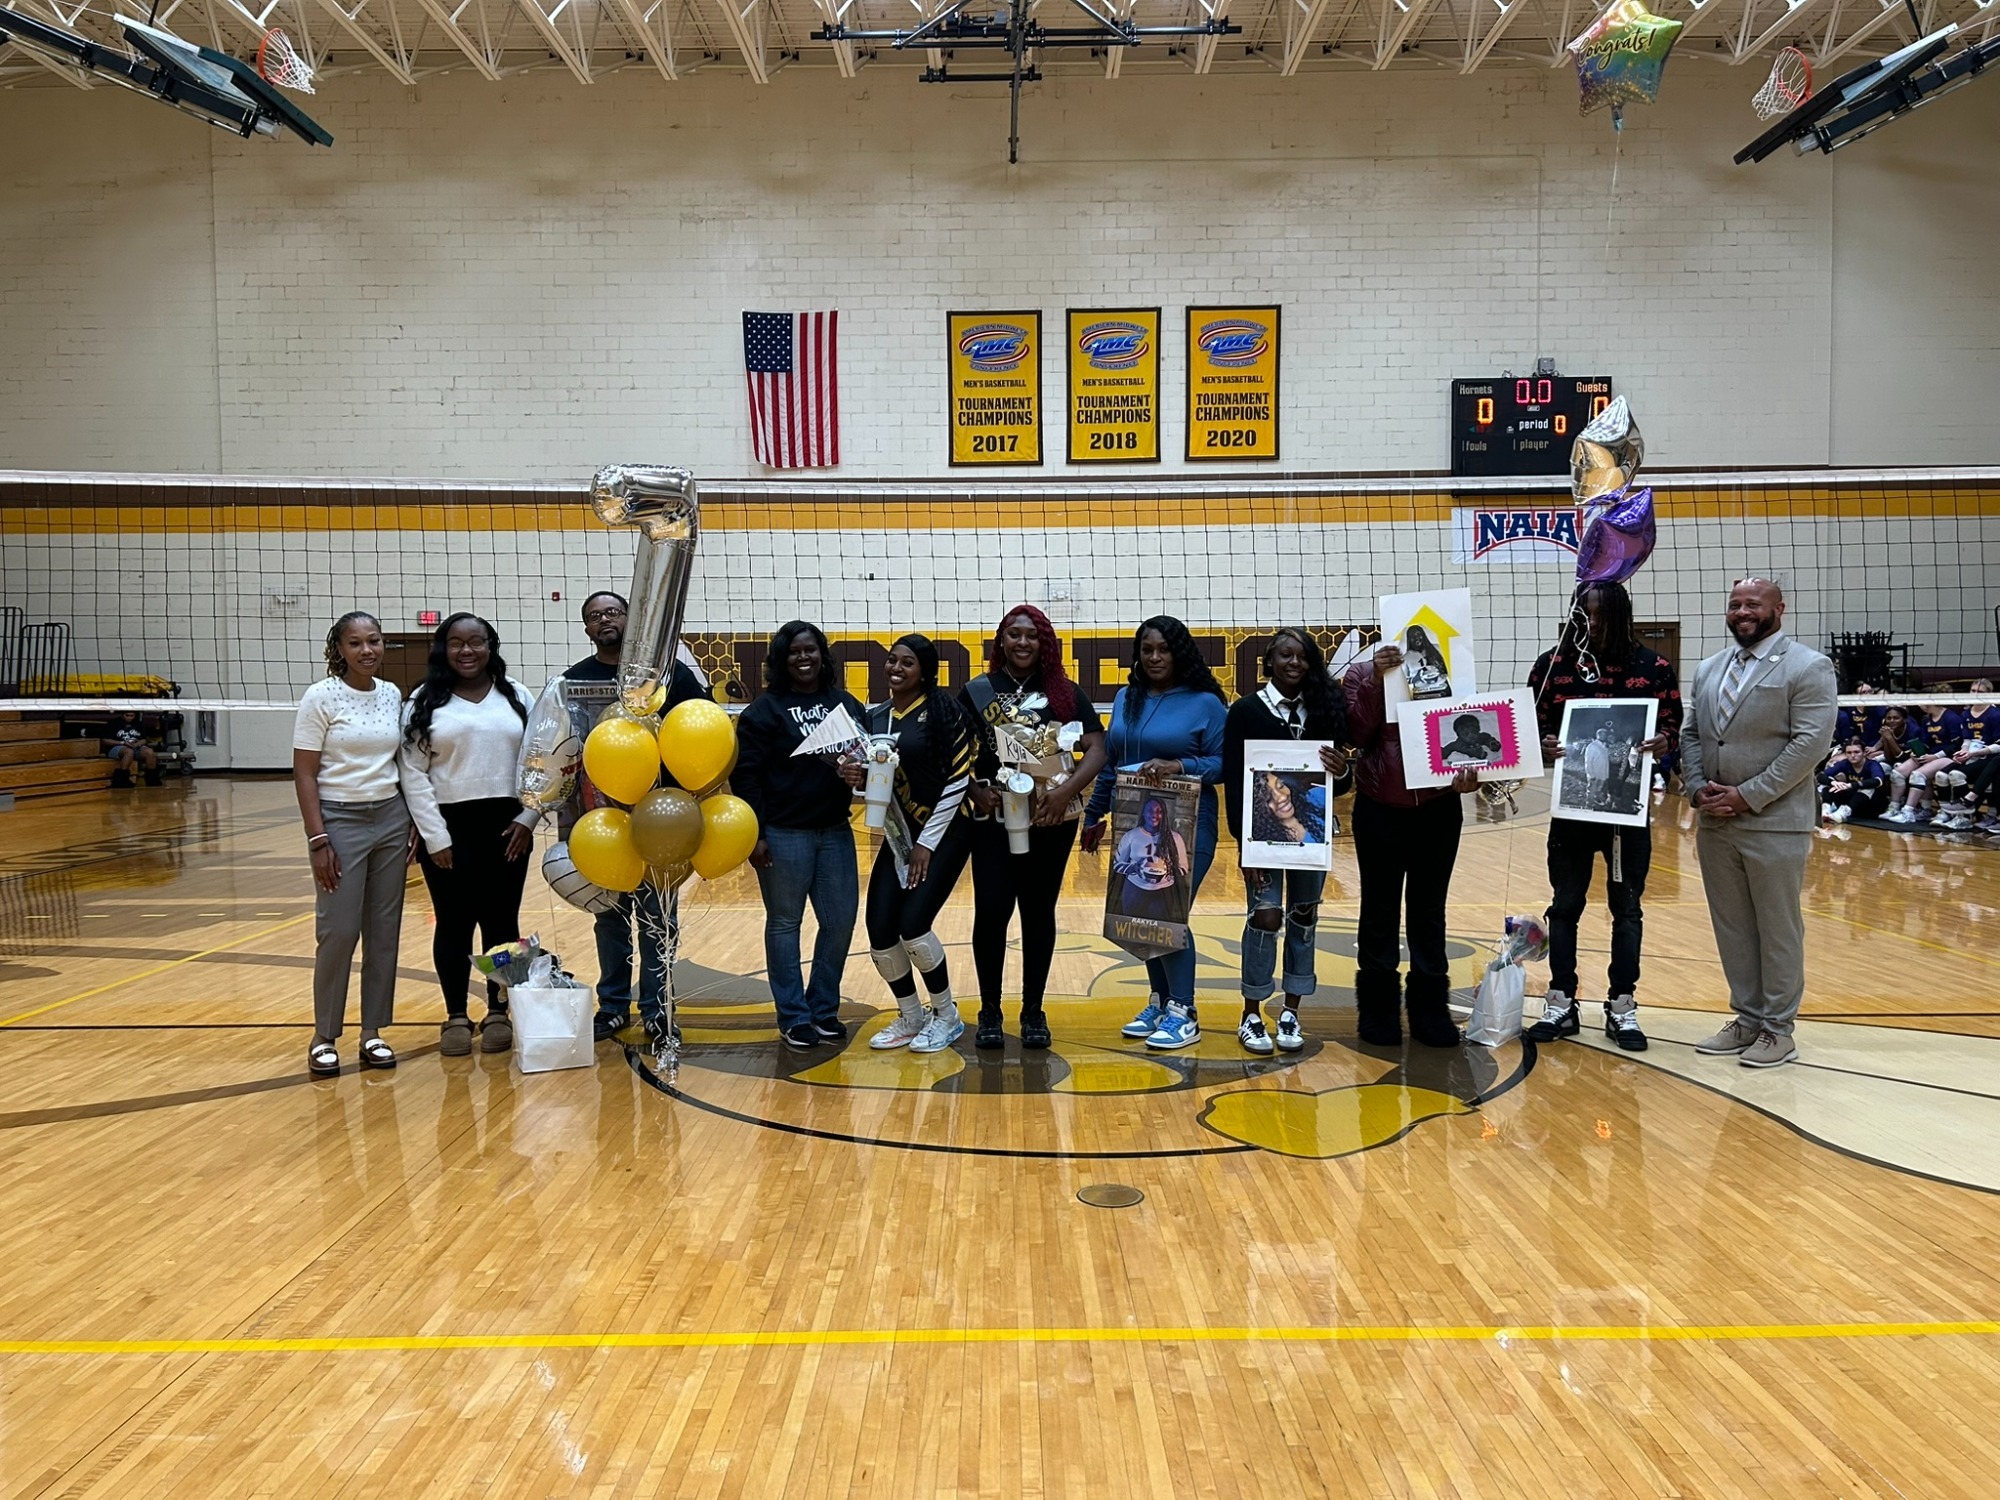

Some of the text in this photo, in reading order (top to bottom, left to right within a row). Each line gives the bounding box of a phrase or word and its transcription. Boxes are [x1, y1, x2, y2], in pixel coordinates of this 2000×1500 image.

[1577, 27, 1657, 70] Congrats!
[963, 337, 1022, 359] AMC
[1083, 335, 1142, 357] AMC
[1201, 334, 1260, 355] AMC
[964, 379, 1026, 388] MEN'S BASKETBALL
[1082, 377, 1145, 386] MEN'S BASKETBALL
[1201, 375, 1264, 384] MEN'S BASKETBALL
[1576, 381, 1608, 393] Guests
[1459, 383, 1493, 395] Hornets
[1516, 380, 1551, 404] 0.0
[958, 397, 1032, 410] TOURNAMENT
[1077, 394, 1150, 408] TOURNAMENT
[1196, 393, 1269, 406] TOURNAMENT
[958, 411, 1032, 426] CHAMPIONS
[1076, 409, 1151, 424] CHAMPIONS
[1196, 406, 1269, 421] CHAMPIONS
[1477, 398, 1494, 425] 0
[1519, 418, 1549, 431] period
[1554, 415, 1566, 433] 0
[973, 435, 1018, 453] 2017
[1090, 432, 1137, 449] 2018
[1207, 430, 1257, 447] 2020
[1466, 440, 1487, 451] fouls
[1519, 439, 1549, 451] player
[1477, 512, 1580, 551] NAIA
[1005, 736, 1028, 762] Kyla
[1162, 780, 1192, 792] STOWE
[1115, 921, 1174, 946] WITCHER
